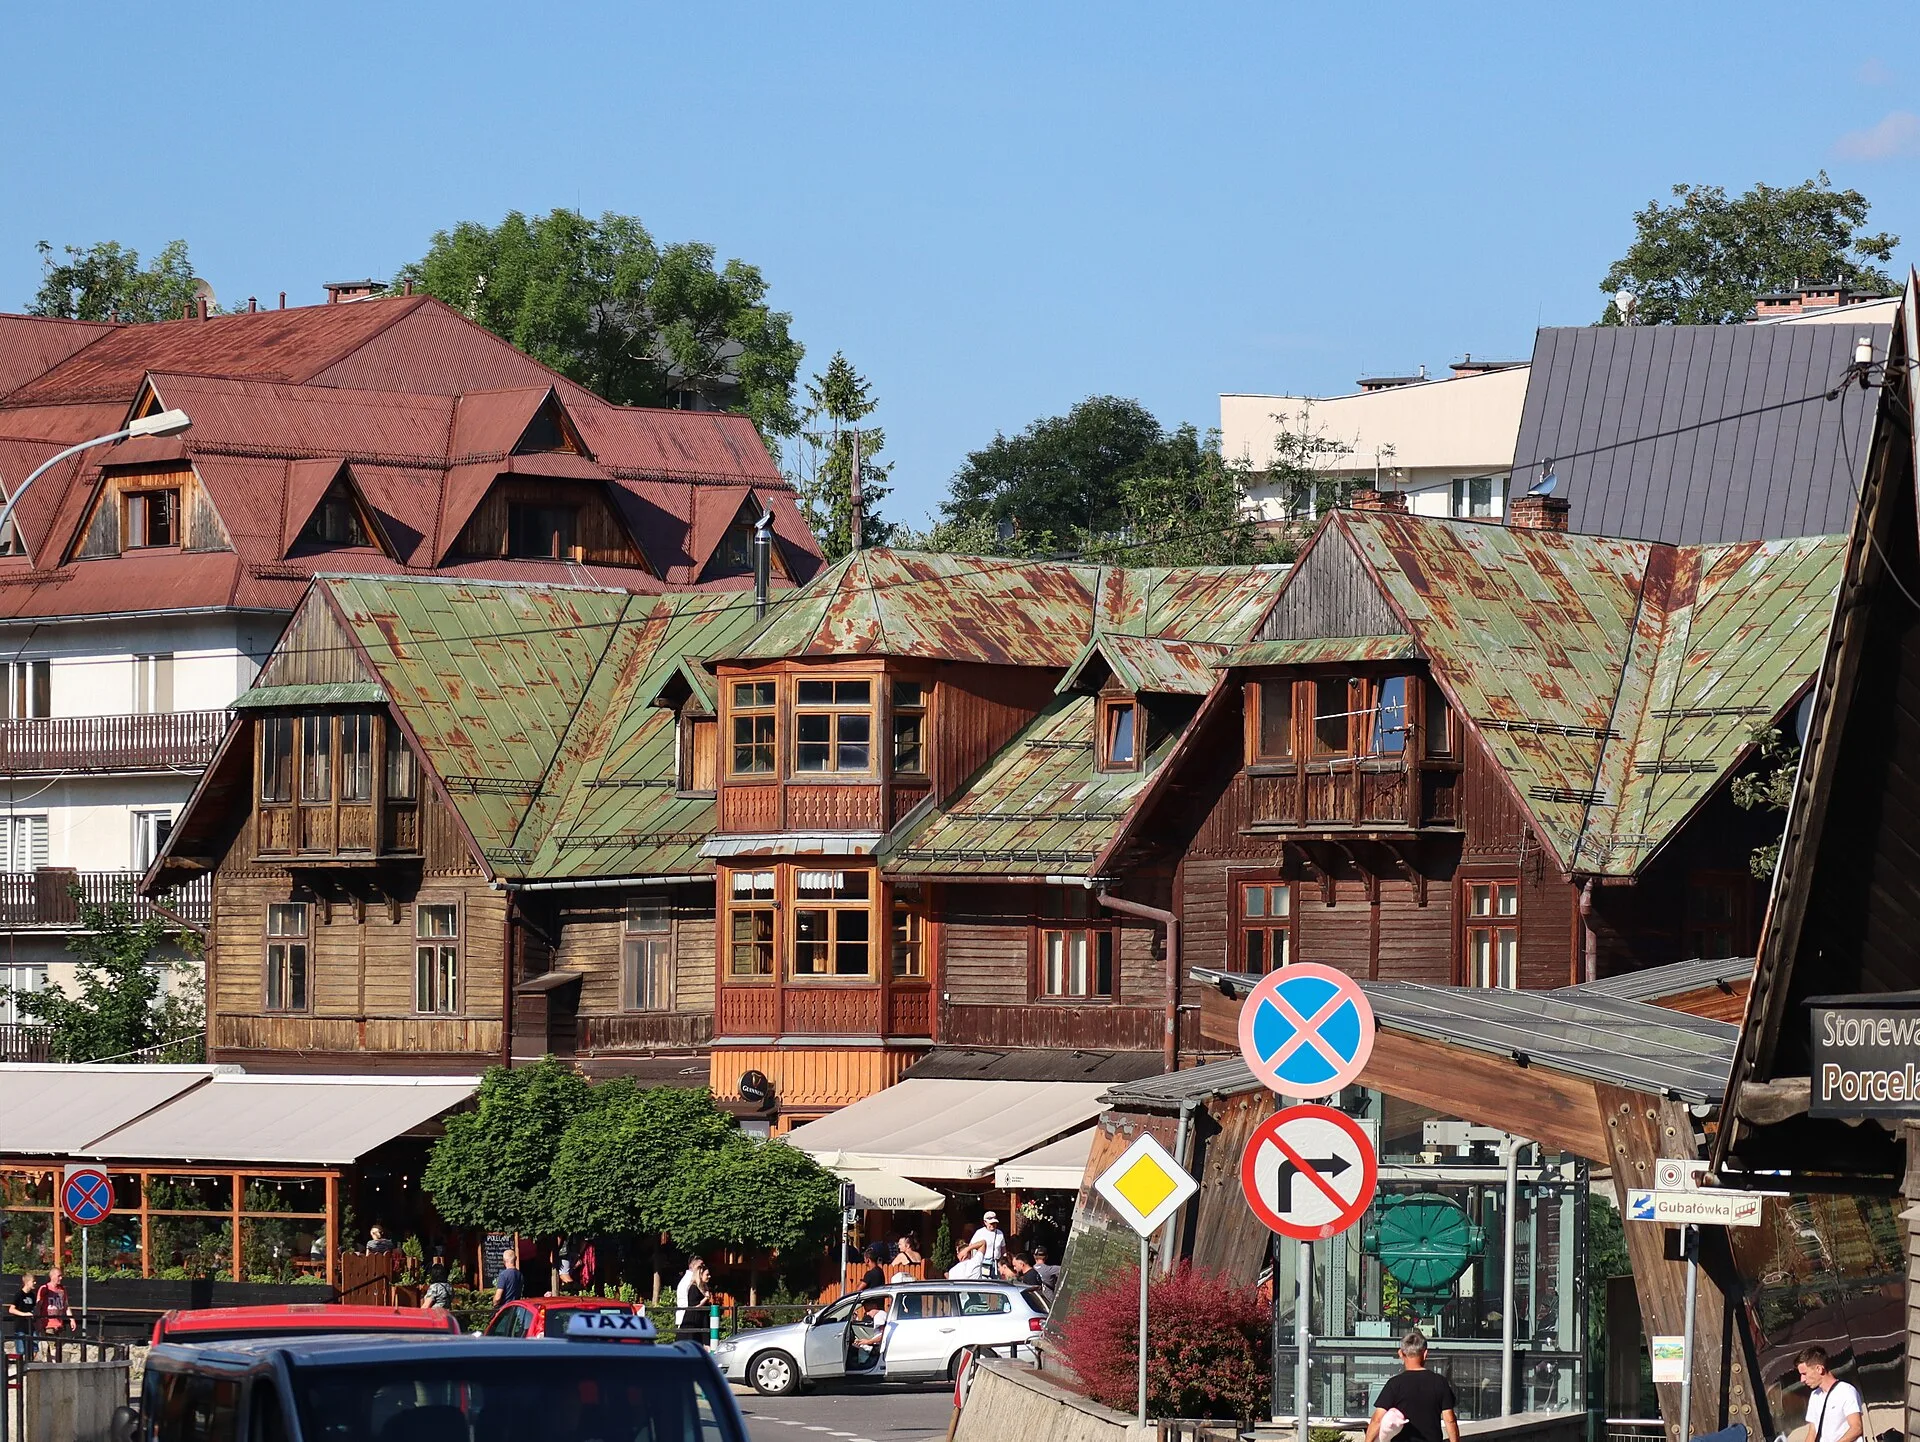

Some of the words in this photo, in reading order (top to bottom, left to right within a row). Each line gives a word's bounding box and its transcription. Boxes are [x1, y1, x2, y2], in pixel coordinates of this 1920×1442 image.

[879, 1197, 905, 1207] OKOCIM
[1658, 1201, 1730, 1216] Gubałówka
[578, 1314, 648, 1330] TAXI
